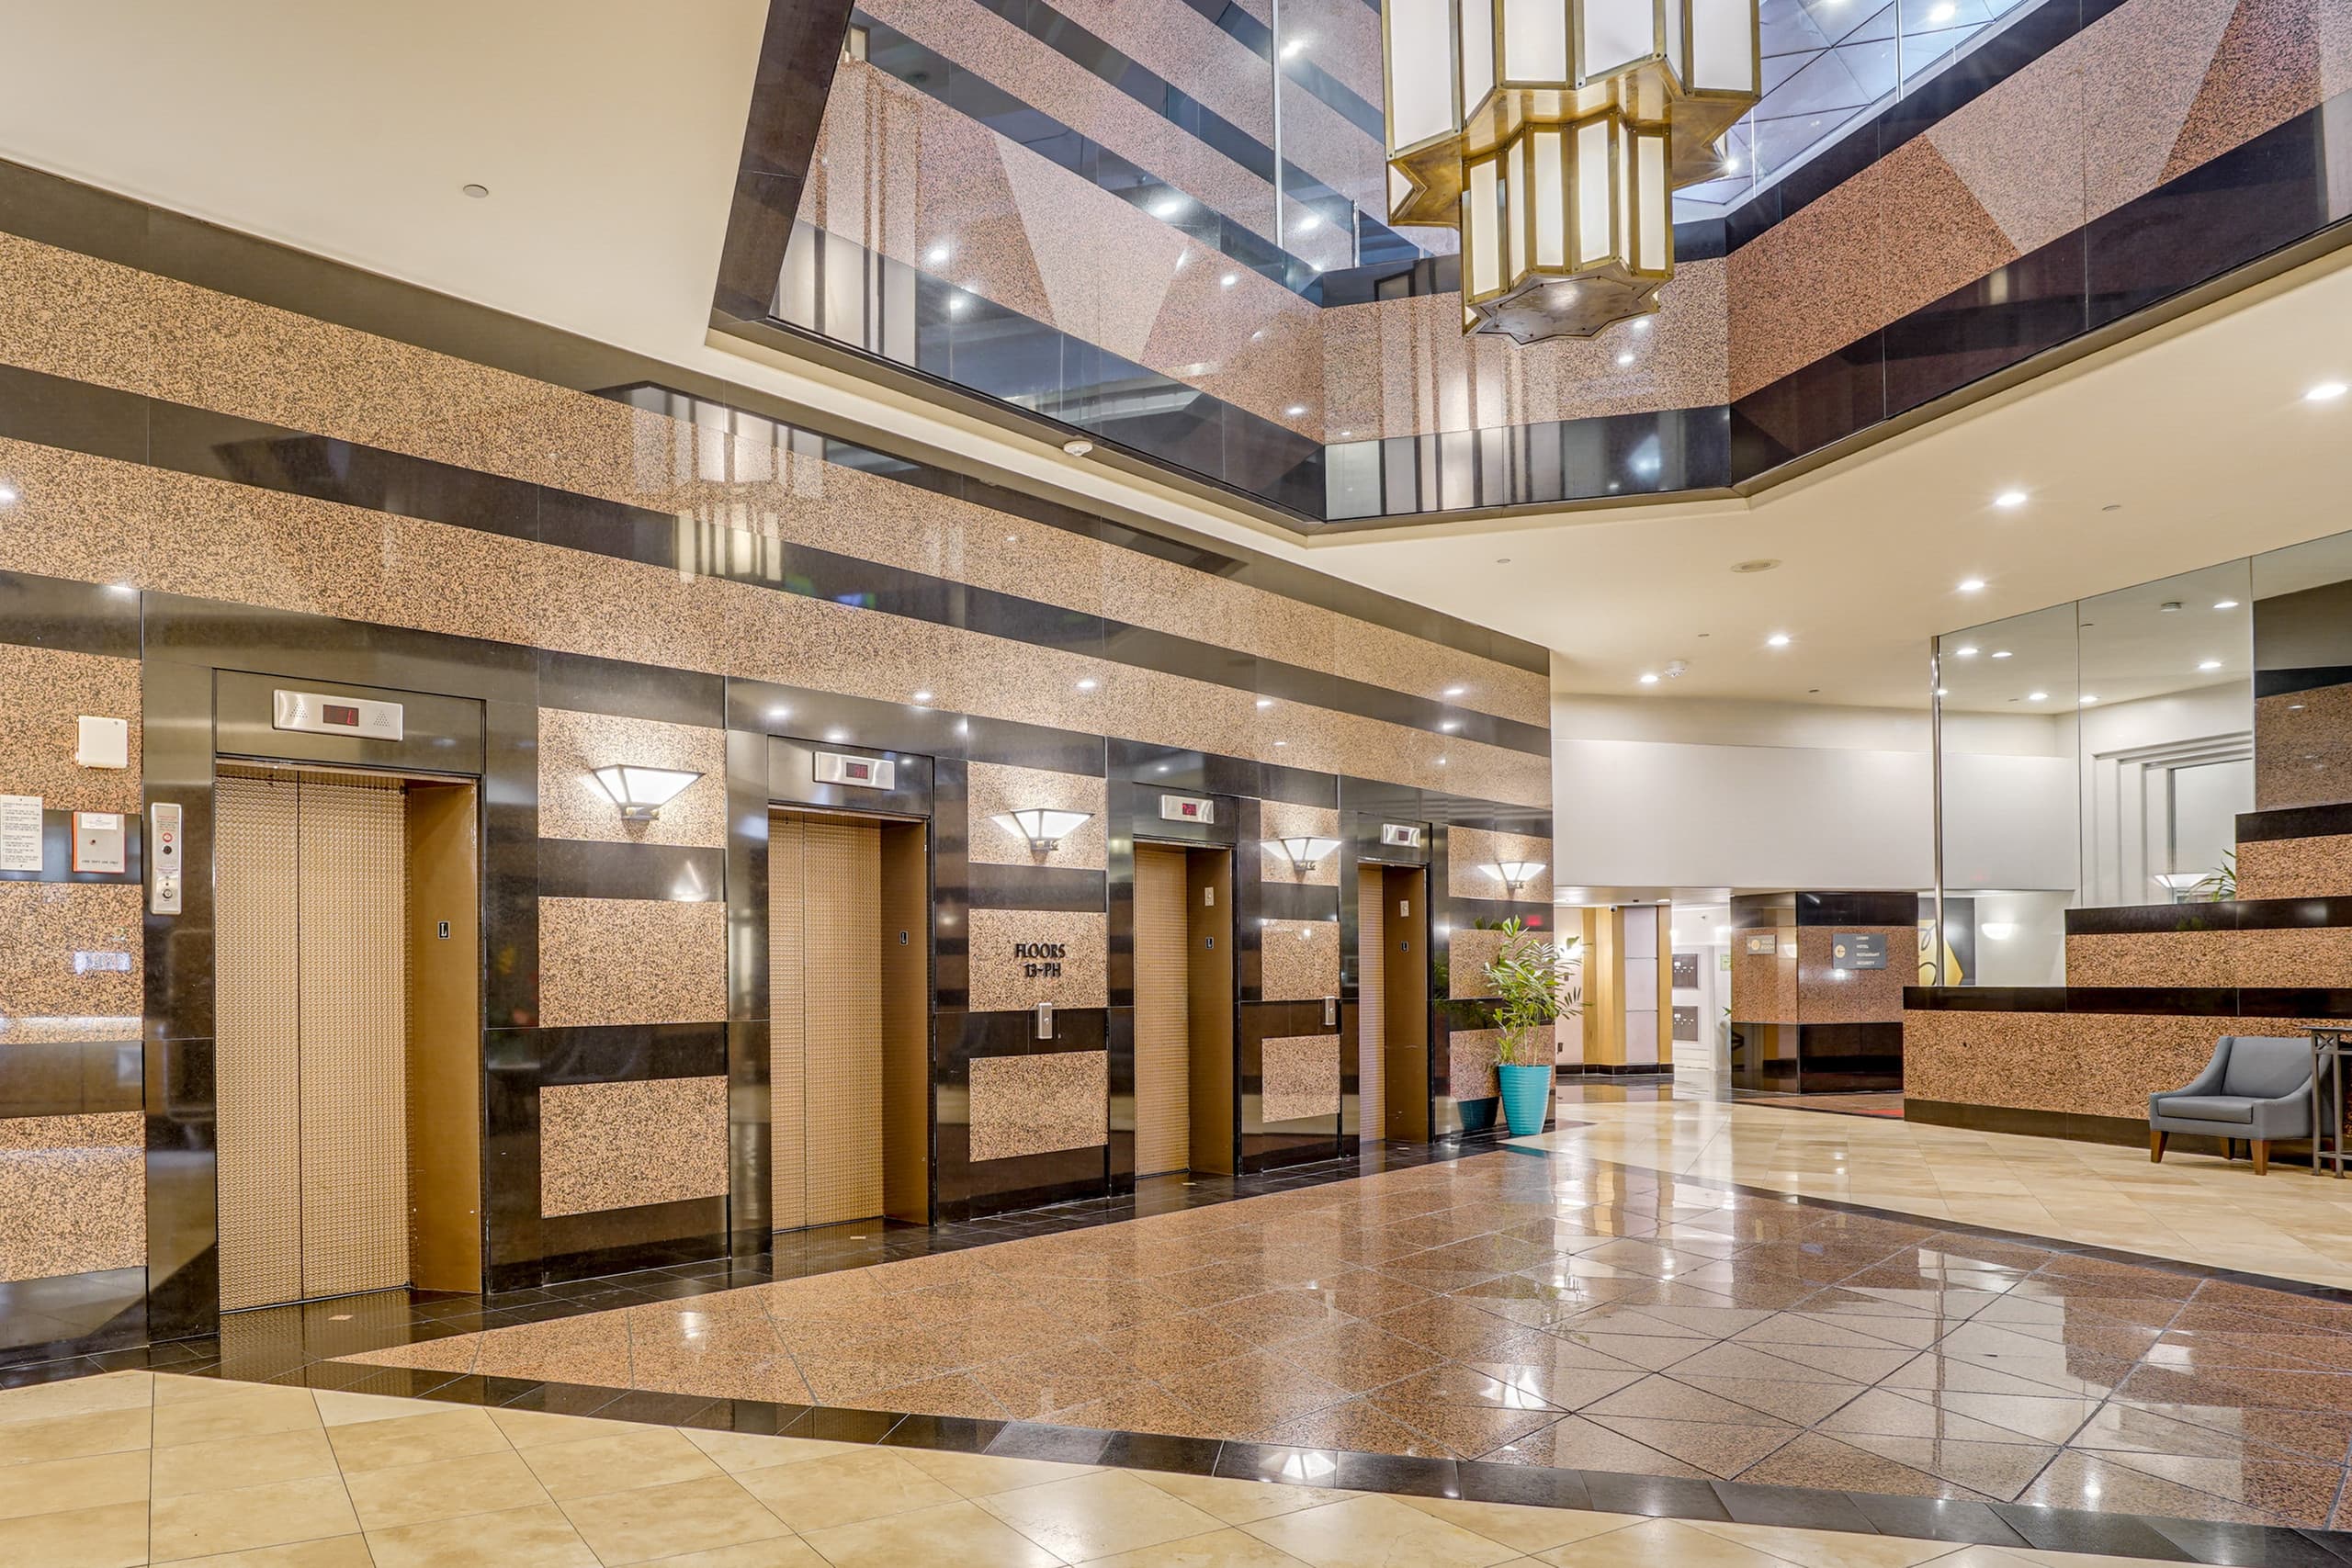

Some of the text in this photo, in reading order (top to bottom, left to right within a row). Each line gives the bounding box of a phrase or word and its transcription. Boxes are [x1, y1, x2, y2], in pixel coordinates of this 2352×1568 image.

[346, 708, 356, 725] L
[441, 923, 447, 936] L
[1014, 942, 1066, 958] FLOORS
